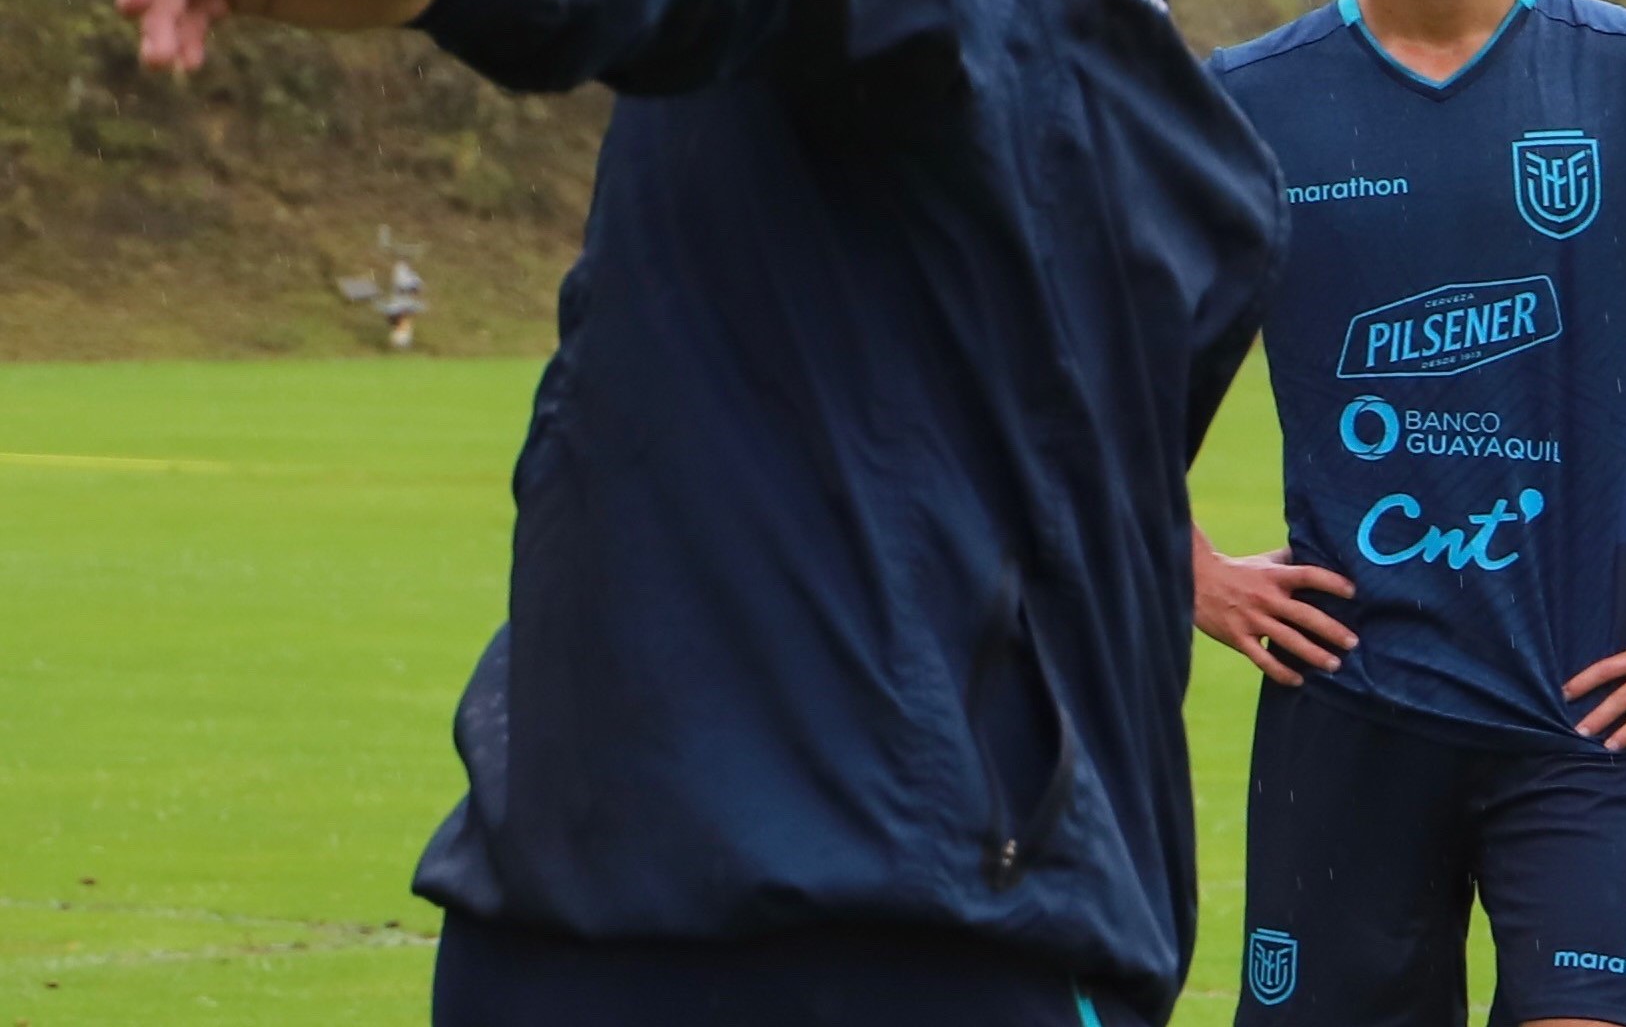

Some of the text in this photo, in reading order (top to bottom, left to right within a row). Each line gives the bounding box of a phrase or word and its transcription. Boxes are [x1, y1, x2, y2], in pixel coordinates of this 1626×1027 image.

[1285, 176, 1408, 203] marathon
[1365, 291, 1538, 368] PILSENER
[1405, 410, 1500, 433] BANCO
[1406, 433, 1561, 463] GUAYAQUIL
